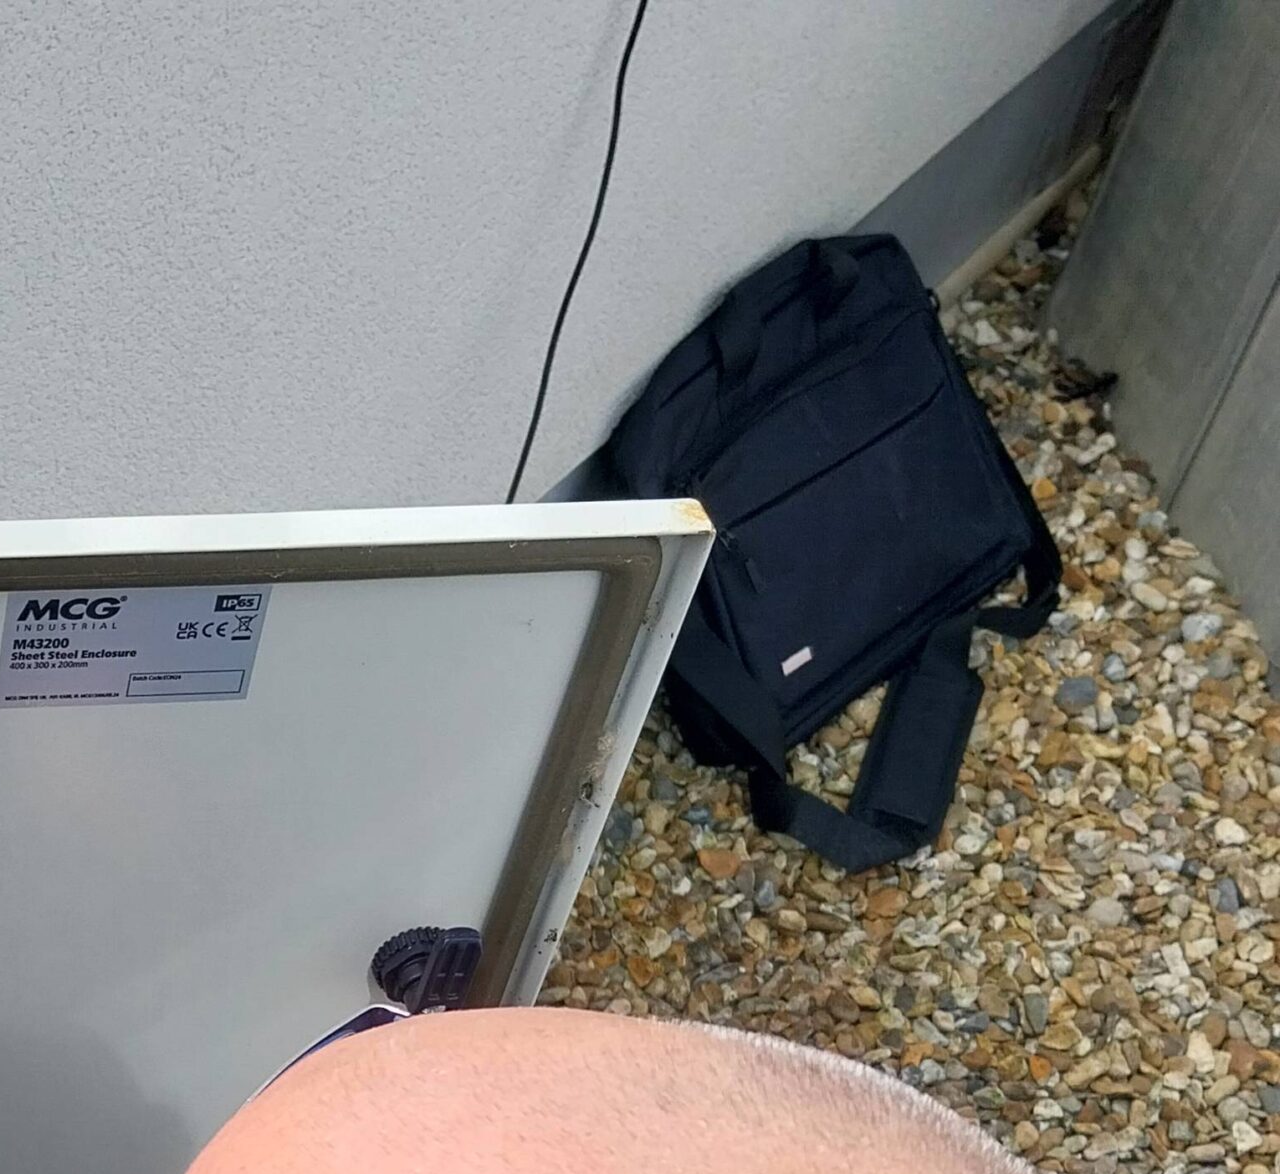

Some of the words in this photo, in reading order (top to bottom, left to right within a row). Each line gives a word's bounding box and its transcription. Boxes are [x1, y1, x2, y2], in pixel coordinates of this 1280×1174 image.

[222, 598, 256, 608] IP65
[16, 622, 117, 632] INDUSTRIAL
[12, 638, 69, 650] M43200
[11, 651, 45, 661] Sheet
[48, 650, 78, 660] Steel
[81, 649, 137, 659] Enclosure
[9, 662, 25, 670] 400
[33, 661, 50, 670] 300
[57, 661, 88, 669] 200mm
